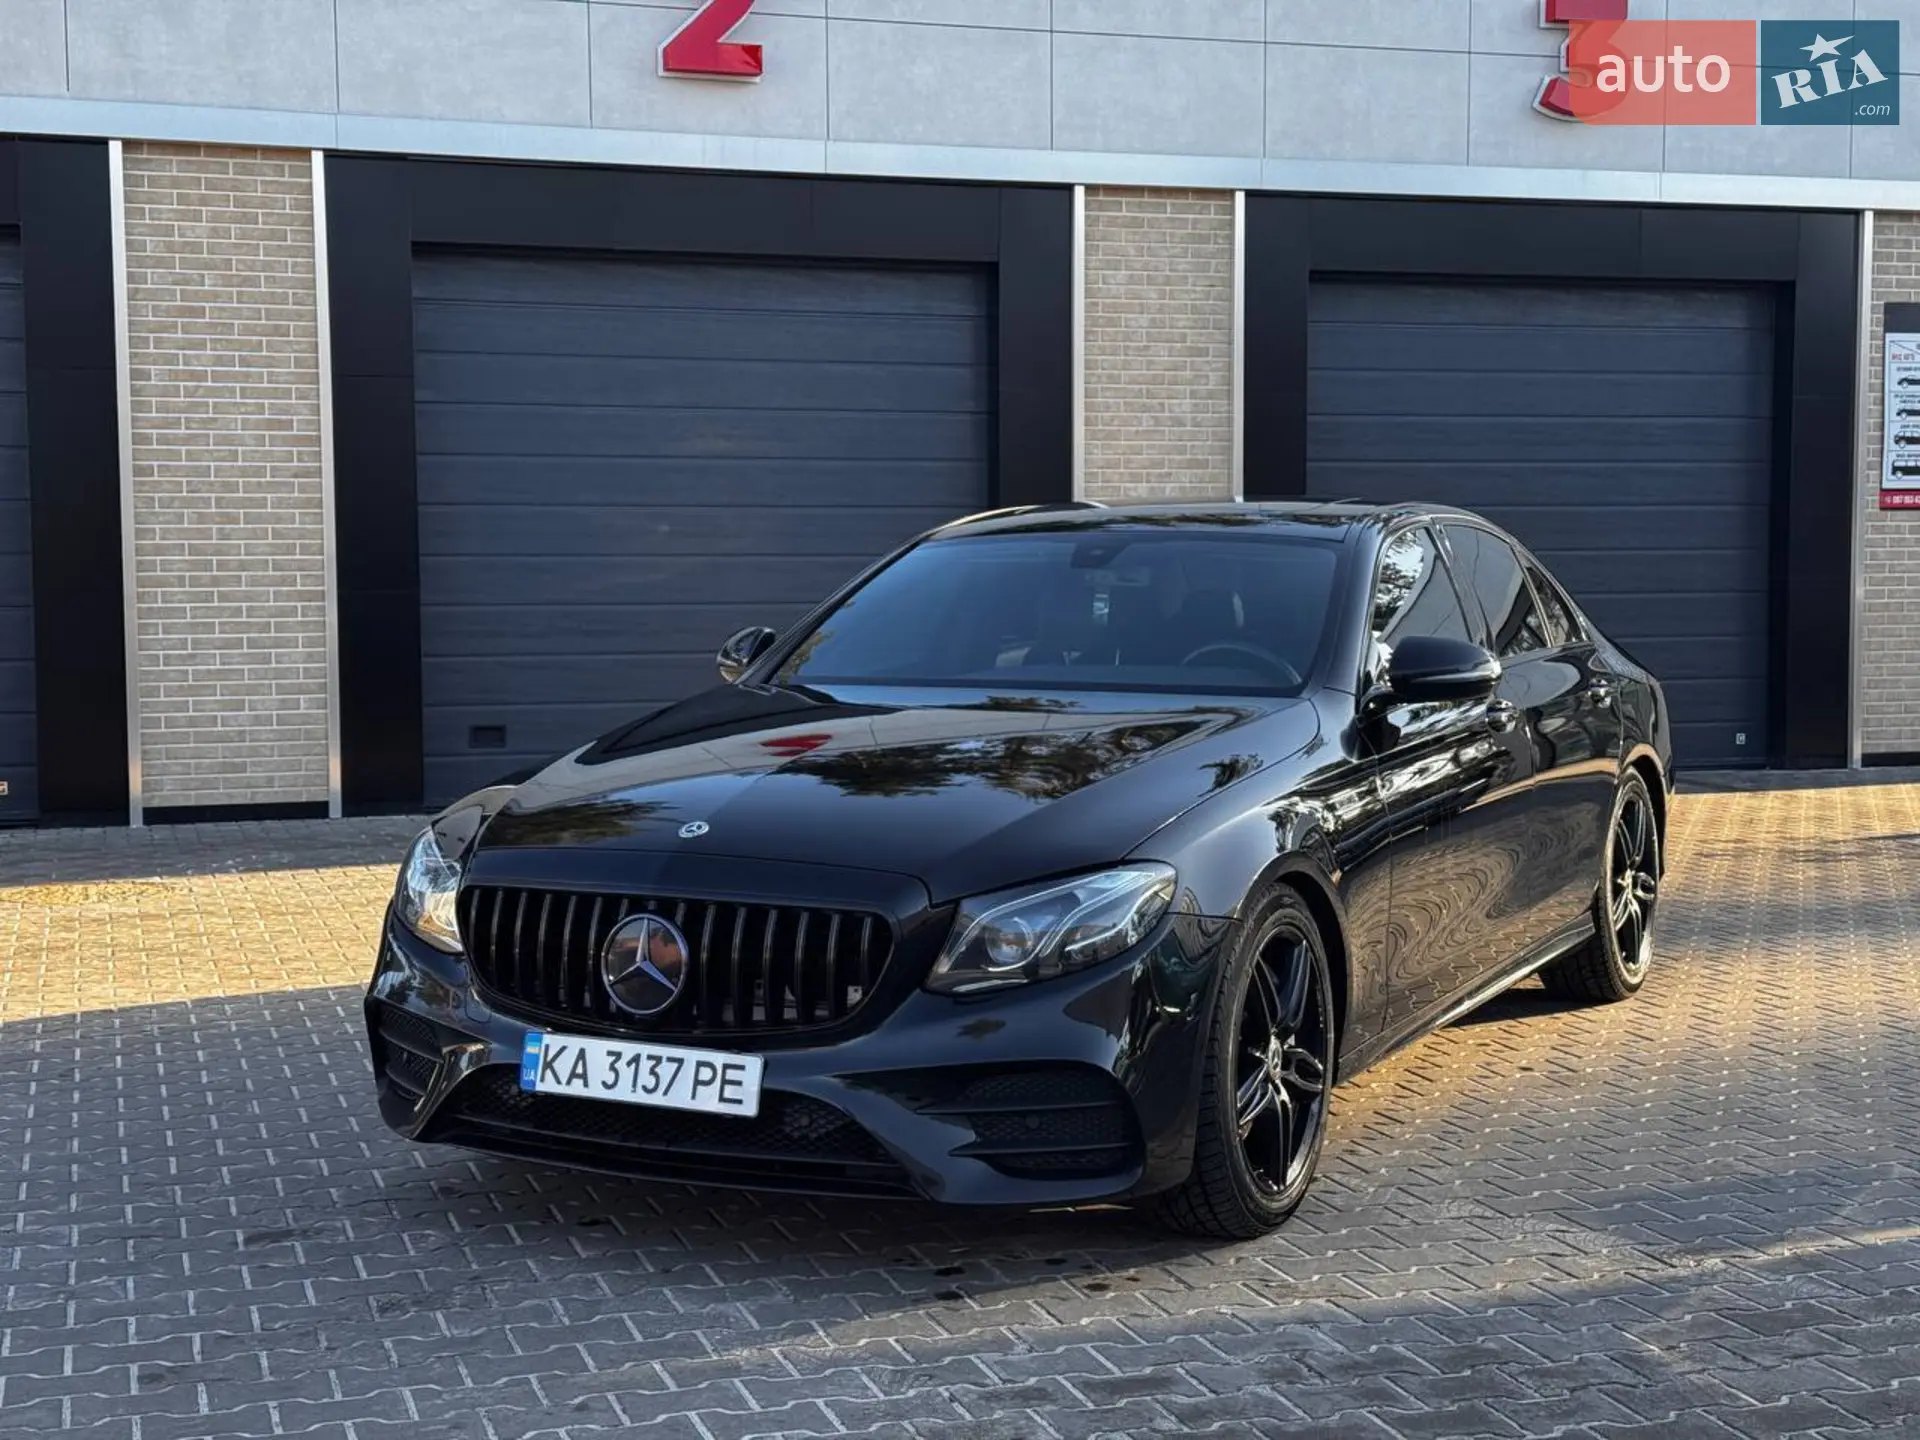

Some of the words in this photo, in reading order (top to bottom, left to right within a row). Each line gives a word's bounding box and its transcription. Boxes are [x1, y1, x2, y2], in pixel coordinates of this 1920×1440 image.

[539, 1043, 590, 1089] KA
[601, 1050, 685, 1097] 3137
[690, 1060, 746, 1105] PE
